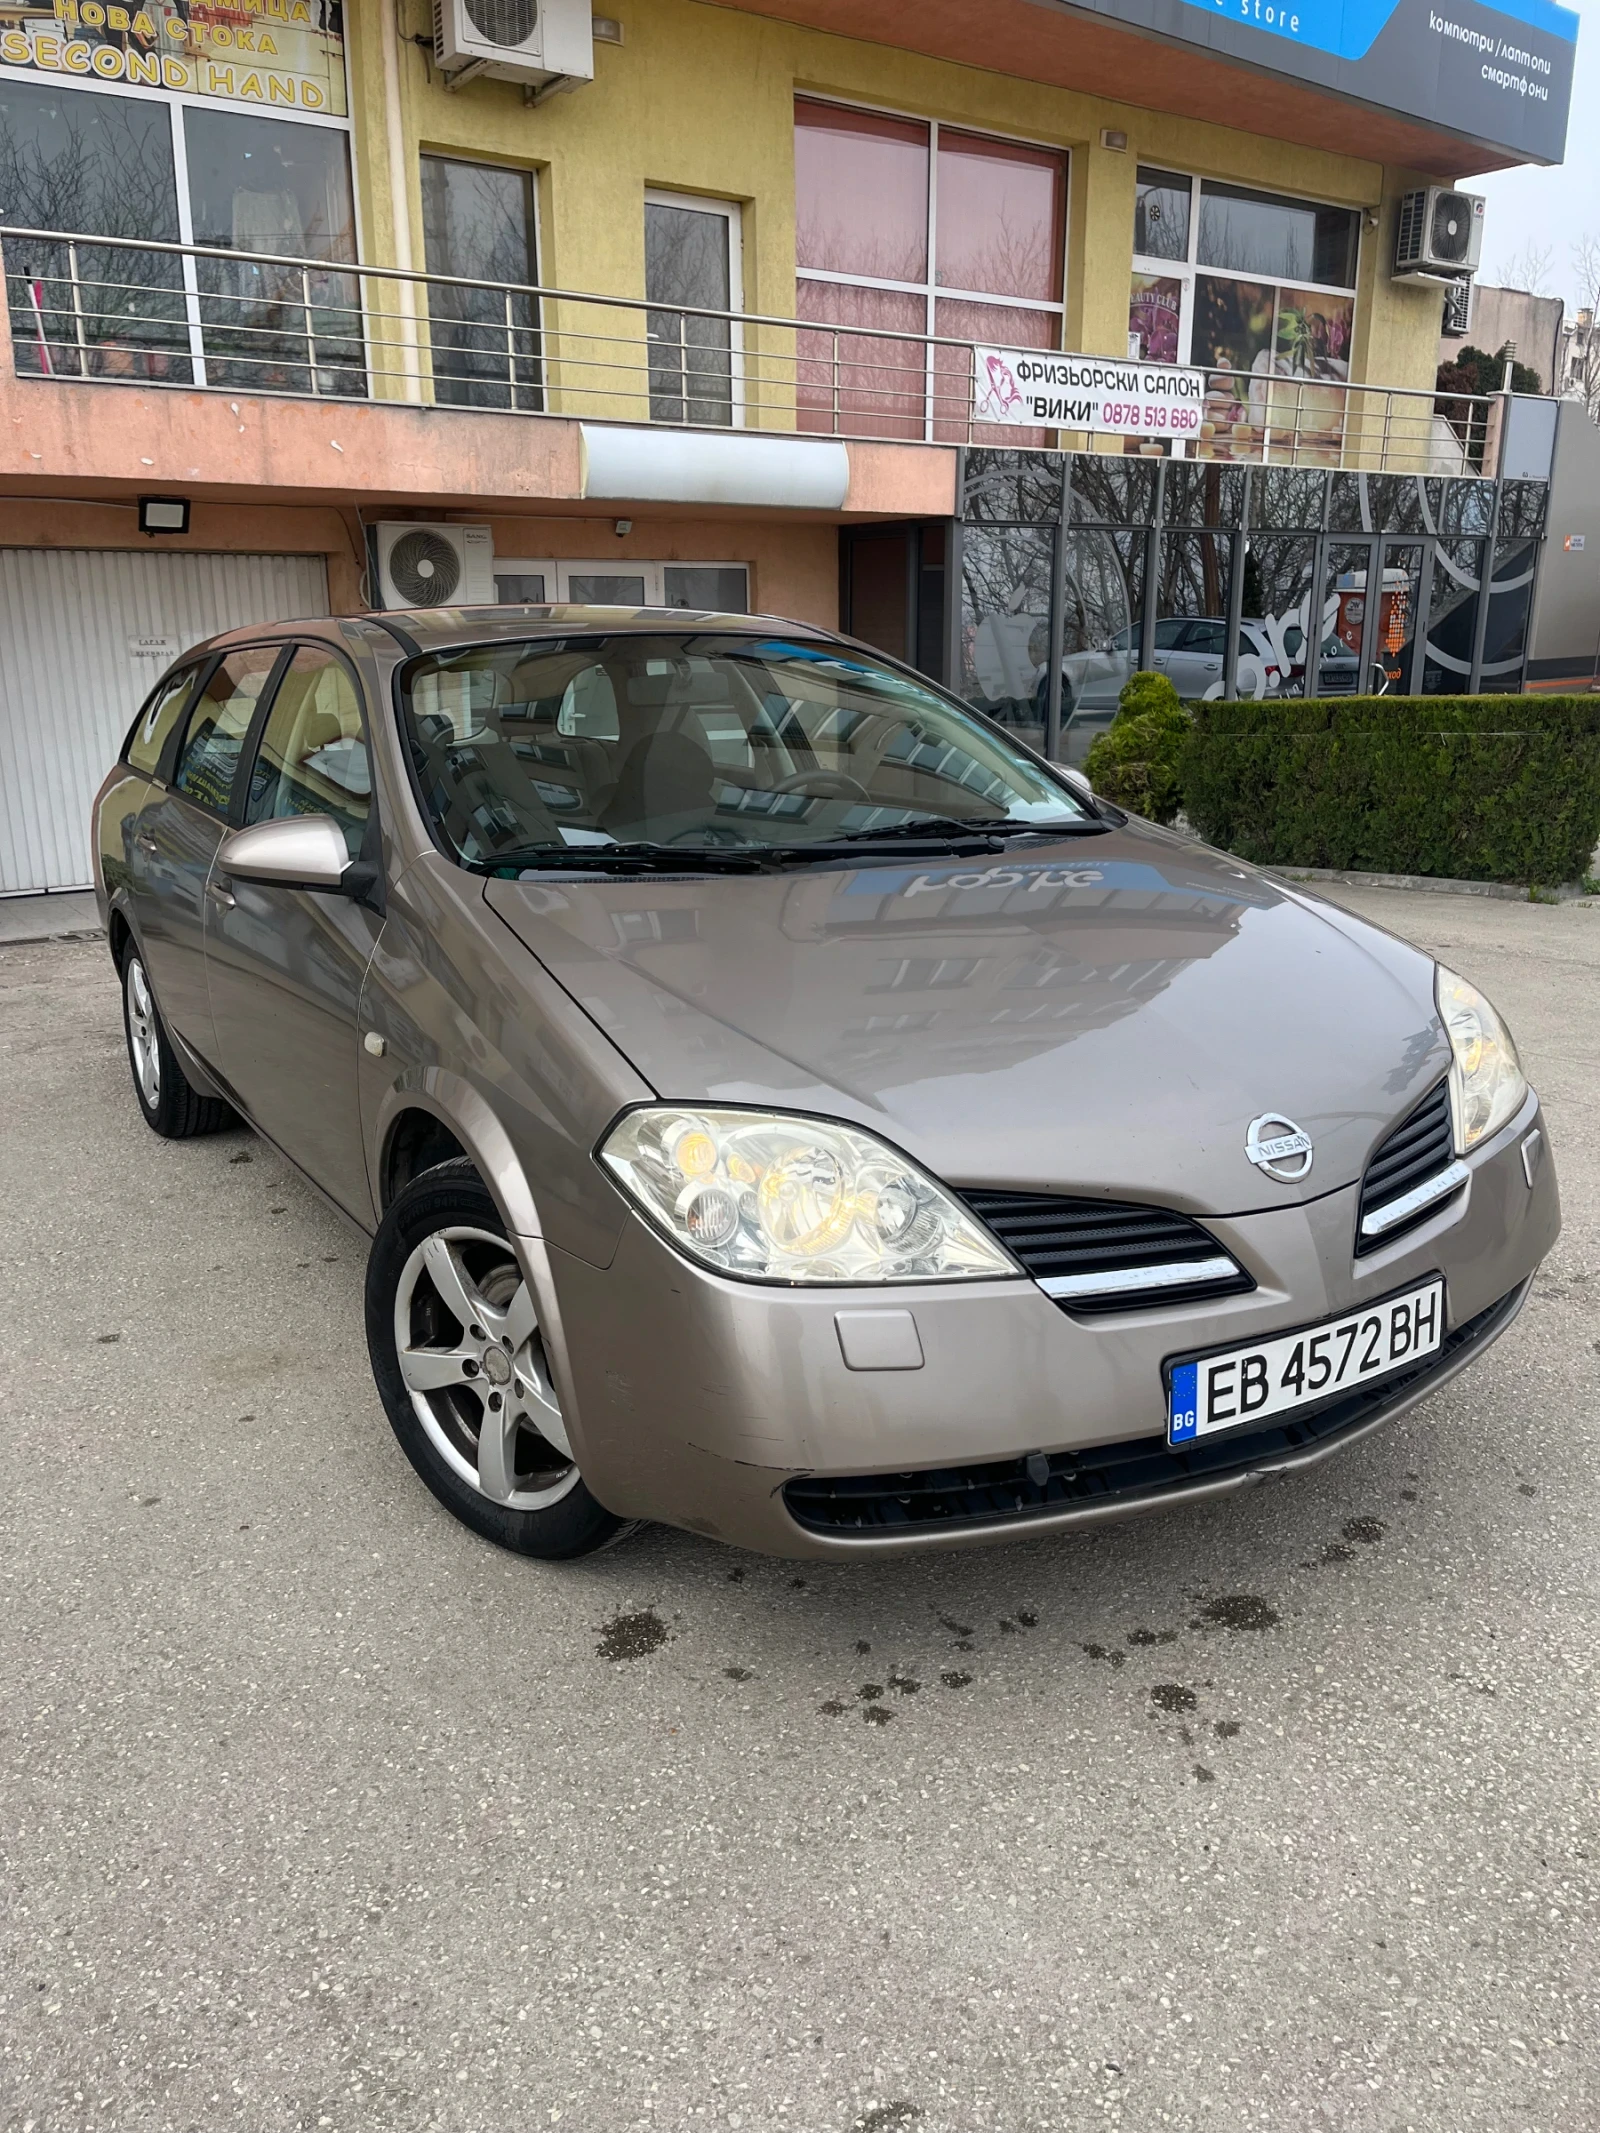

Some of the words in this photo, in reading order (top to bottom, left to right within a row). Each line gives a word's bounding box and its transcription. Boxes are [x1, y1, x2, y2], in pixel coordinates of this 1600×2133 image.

[54, 0, 156, 34] НОВА
[166, 19, 278, 55] СТОКА
[1241, 0, 1299, 31] store
[2, 32, 188, 87] SECOND
[209, 65, 323, 108] HAND
[1481, 64, 1549, 101] смартфони
[1156, 294, 1177, 311] CLUB
[1016, 360, 1139, 393] ФРИЗЬОРСКИ
[1144, 374, 1200, 398] САЛОН
[1026, 395, 1098, 422] "ВИКИ"
[1102, 402, 1140, 426] 0878
[1144, 405, 1167, 427] 513
[1170, 408, 1198, 429] 680
[1087, 635, 1119, 650] iStore
[1258, 1135, 1310, 1157] NISSAN
[1207, 1354, 1269, 1424] EB
[1280, 1316, 1383, 1397] 4572
[1389, 1290, 1437, 1361] BH
[1173, 1410, 1194, 1432] BG
